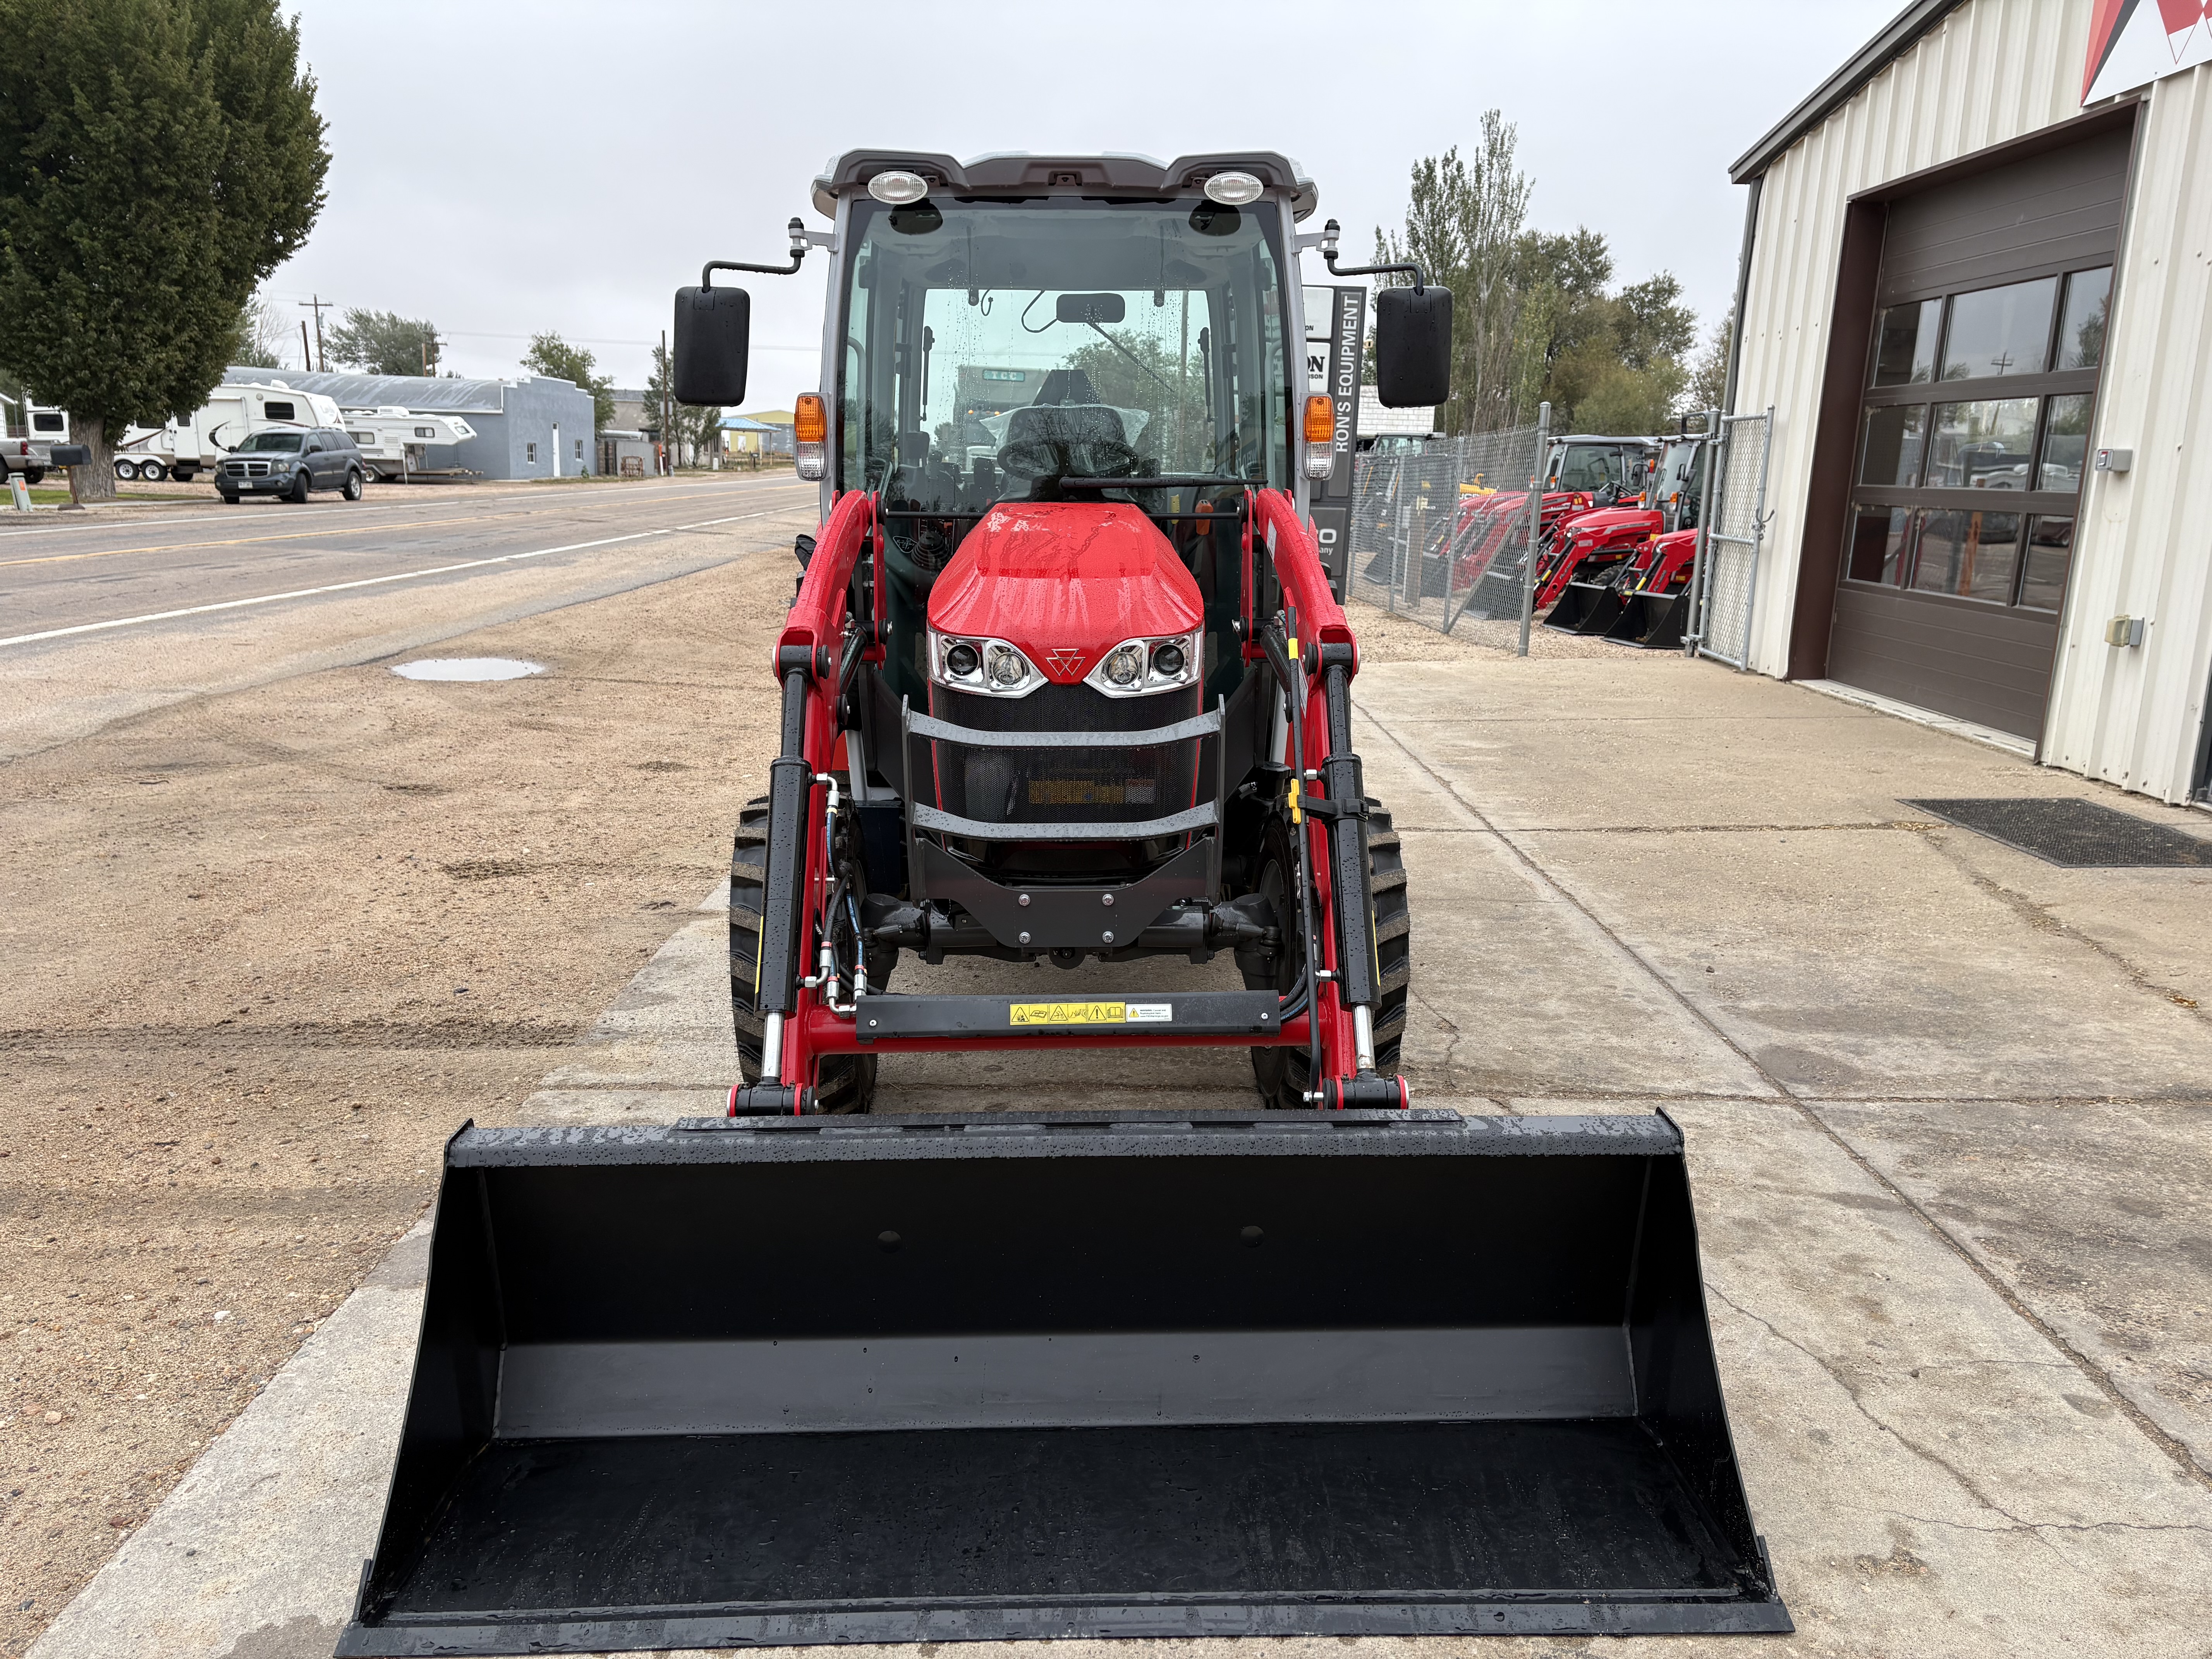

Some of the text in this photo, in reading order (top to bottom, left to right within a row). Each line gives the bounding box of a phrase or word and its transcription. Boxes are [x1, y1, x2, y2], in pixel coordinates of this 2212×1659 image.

[1336, 295, 1358, 452] RON'S EQUIPMENT
[1316, 529, 1336, 544] O
